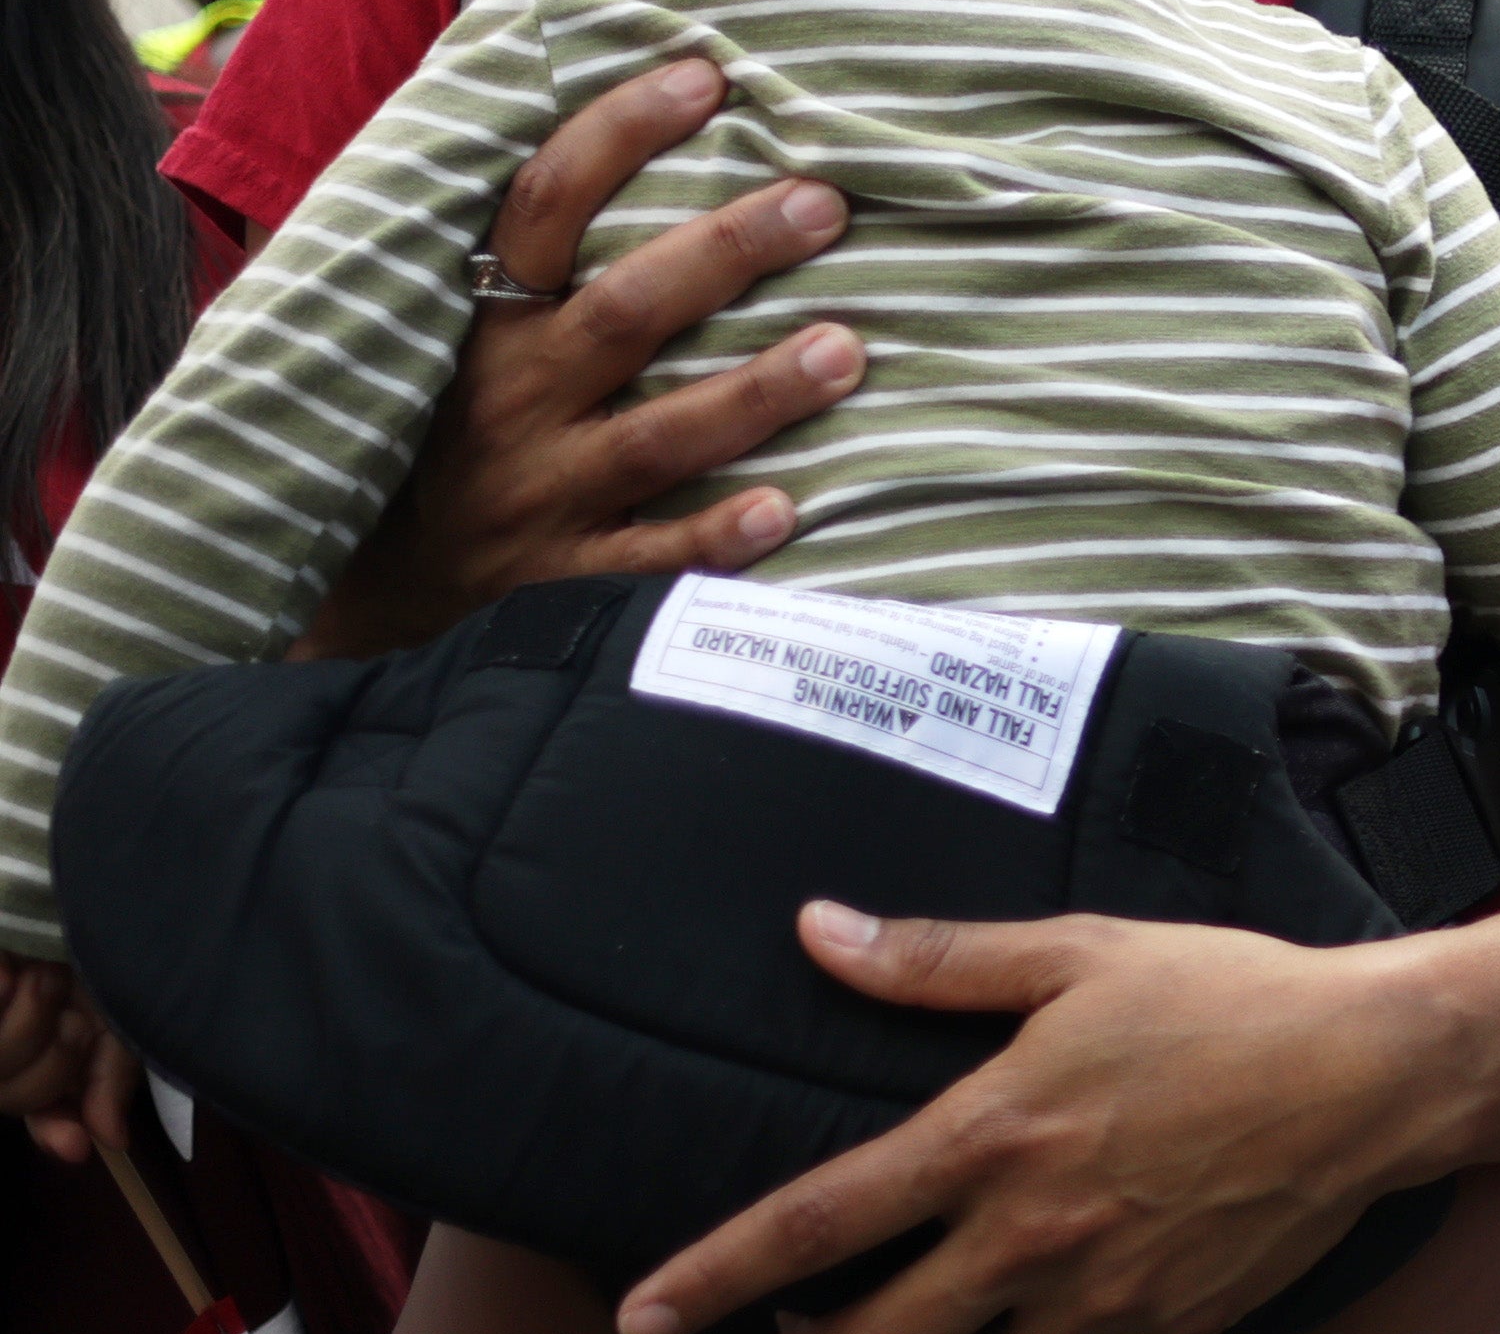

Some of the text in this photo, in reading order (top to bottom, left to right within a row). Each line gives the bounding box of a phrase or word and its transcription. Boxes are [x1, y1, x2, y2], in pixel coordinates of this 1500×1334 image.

[791, 612, 833, 631] through
[834, 621, 853, 637] fall
[856, 627, 878, 641] can
[878, 634, 919, 656] Infants
[931, 651, 1013, 698] HAZARD
[1023, 667, 1036, 682] of
[1039, 672, 1056, 688] out
[692, 626, 1036, 747] FALL AND SUFFOCATION HAZARD
[1057, 680, 1070, 694] or
[794, 678, 897, 731] WARNING
[1016, 681, 1064, 719] FALL
